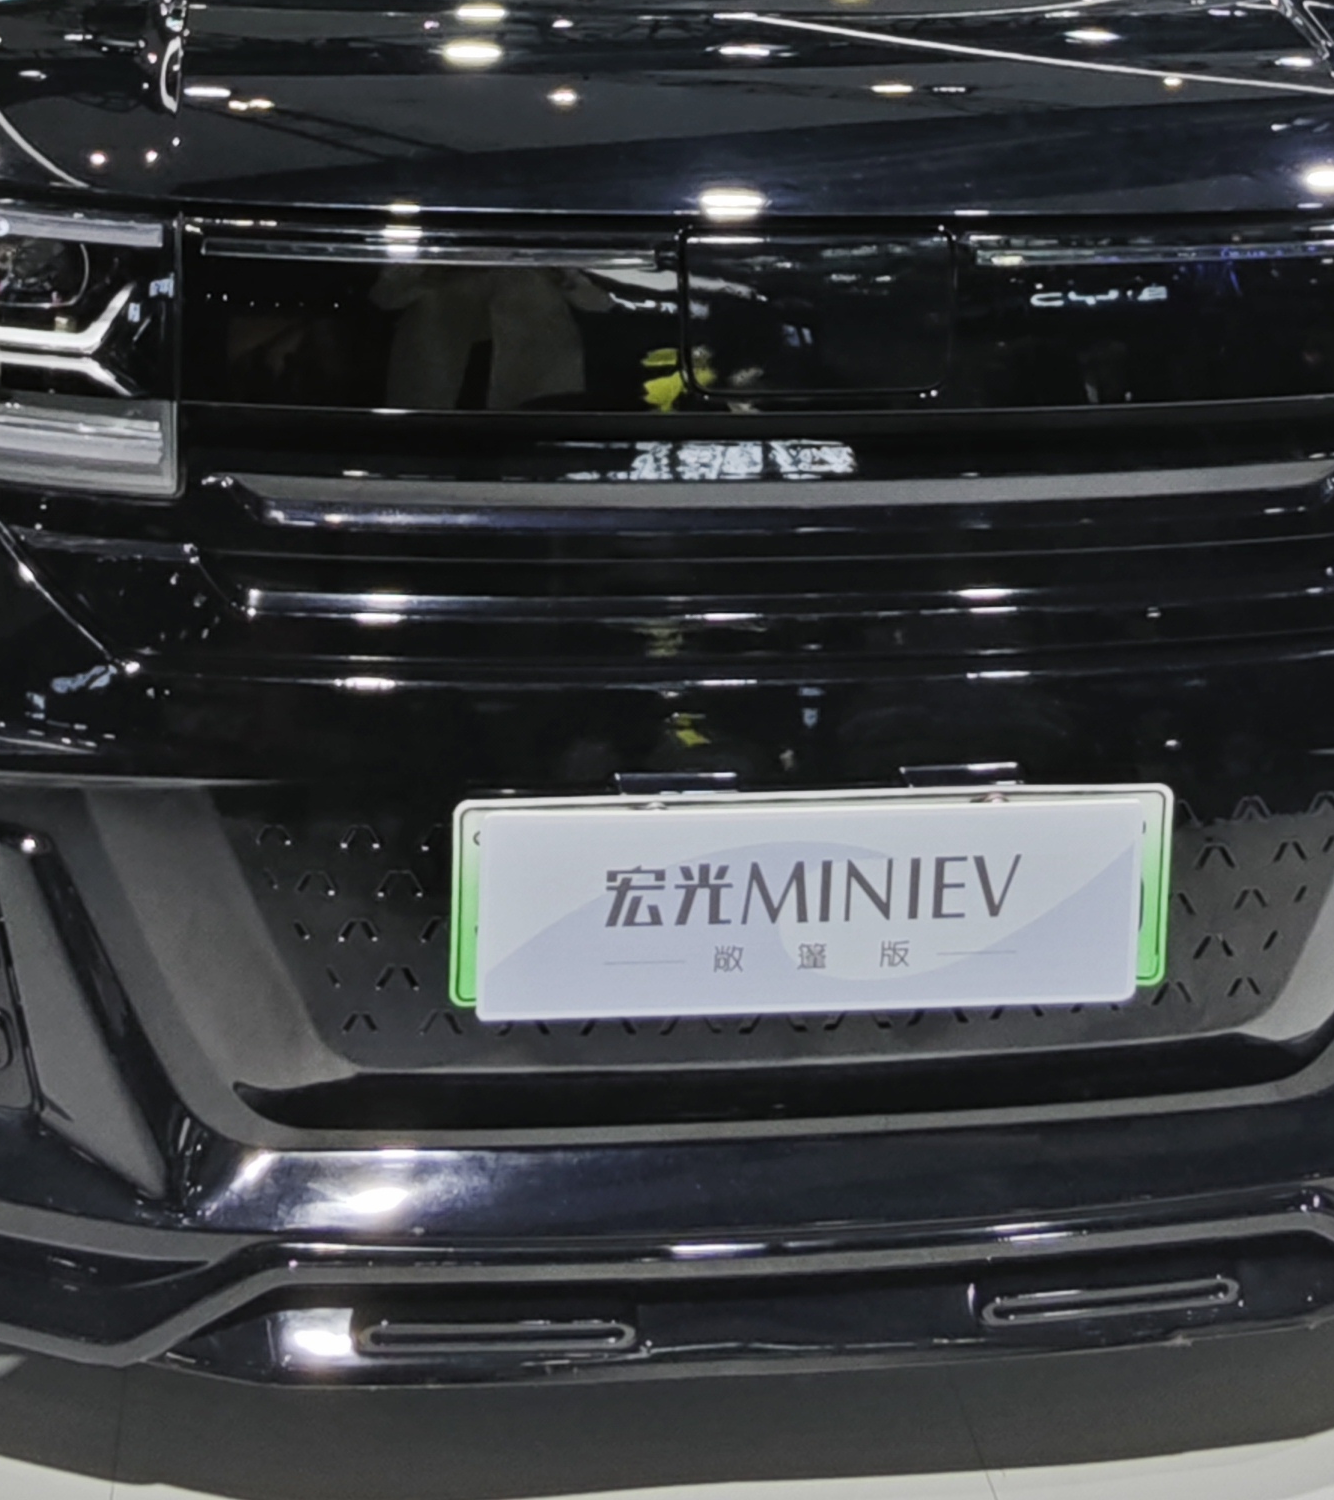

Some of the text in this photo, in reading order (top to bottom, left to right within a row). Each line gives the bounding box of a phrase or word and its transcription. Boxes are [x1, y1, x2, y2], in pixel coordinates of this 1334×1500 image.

[605, 854, 1022, 927] 宏光MINIEV
[713, 940, 911, 972] 敞篷版
